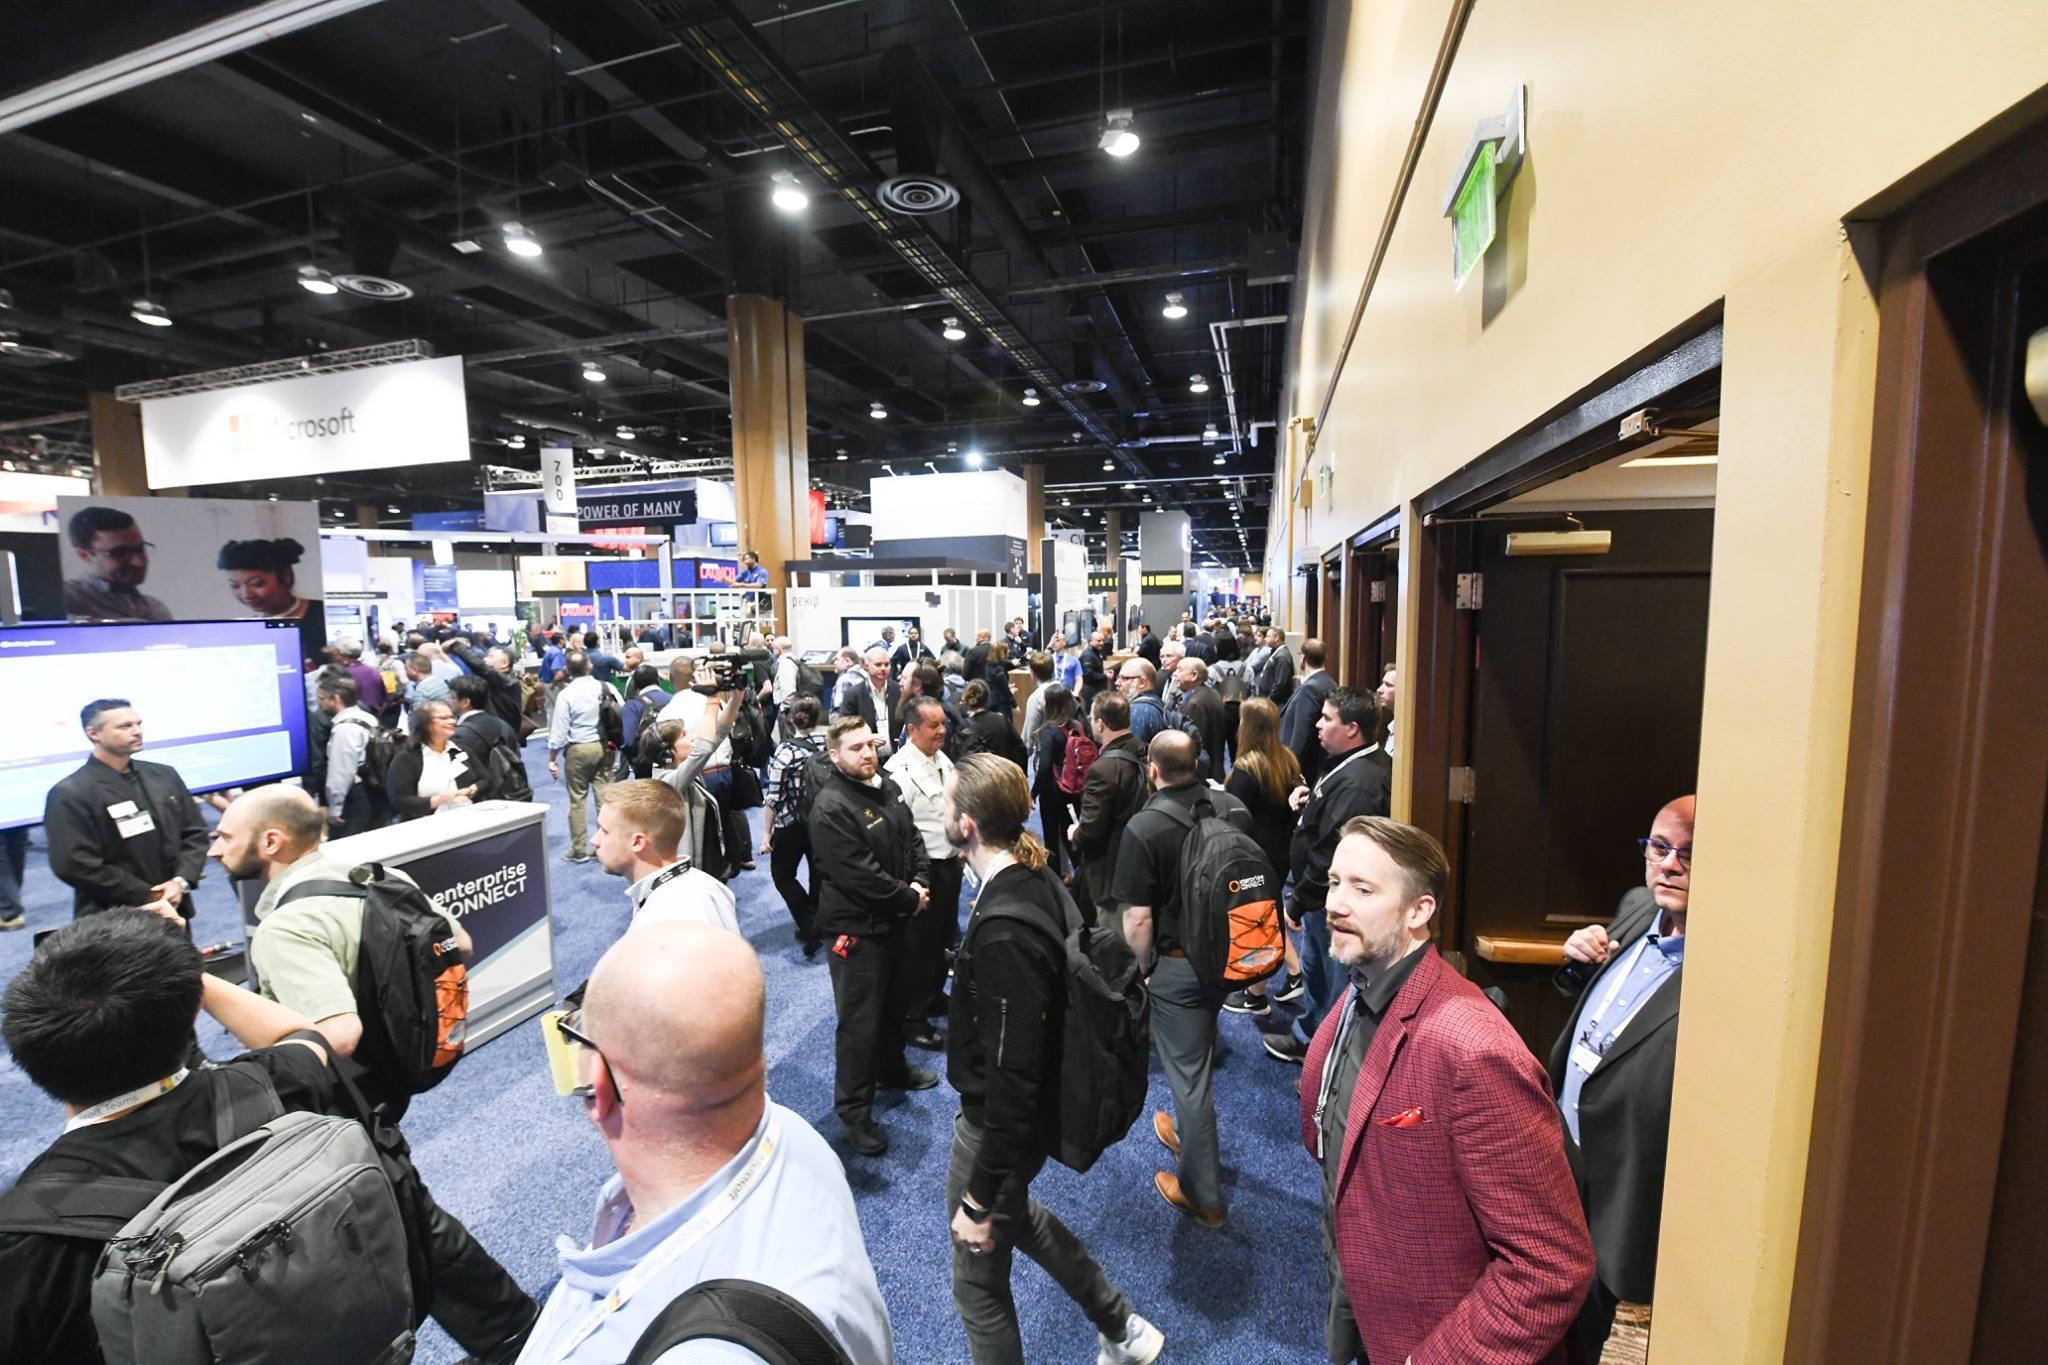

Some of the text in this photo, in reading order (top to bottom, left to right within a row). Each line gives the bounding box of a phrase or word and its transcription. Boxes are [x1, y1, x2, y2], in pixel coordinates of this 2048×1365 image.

[268, 406, 355, 440] crosoft
[553, 460, 563, 500] 700
[577, 500, 682, 519] POWER OF MANY
[432, 862, 527, 904] enterprise
